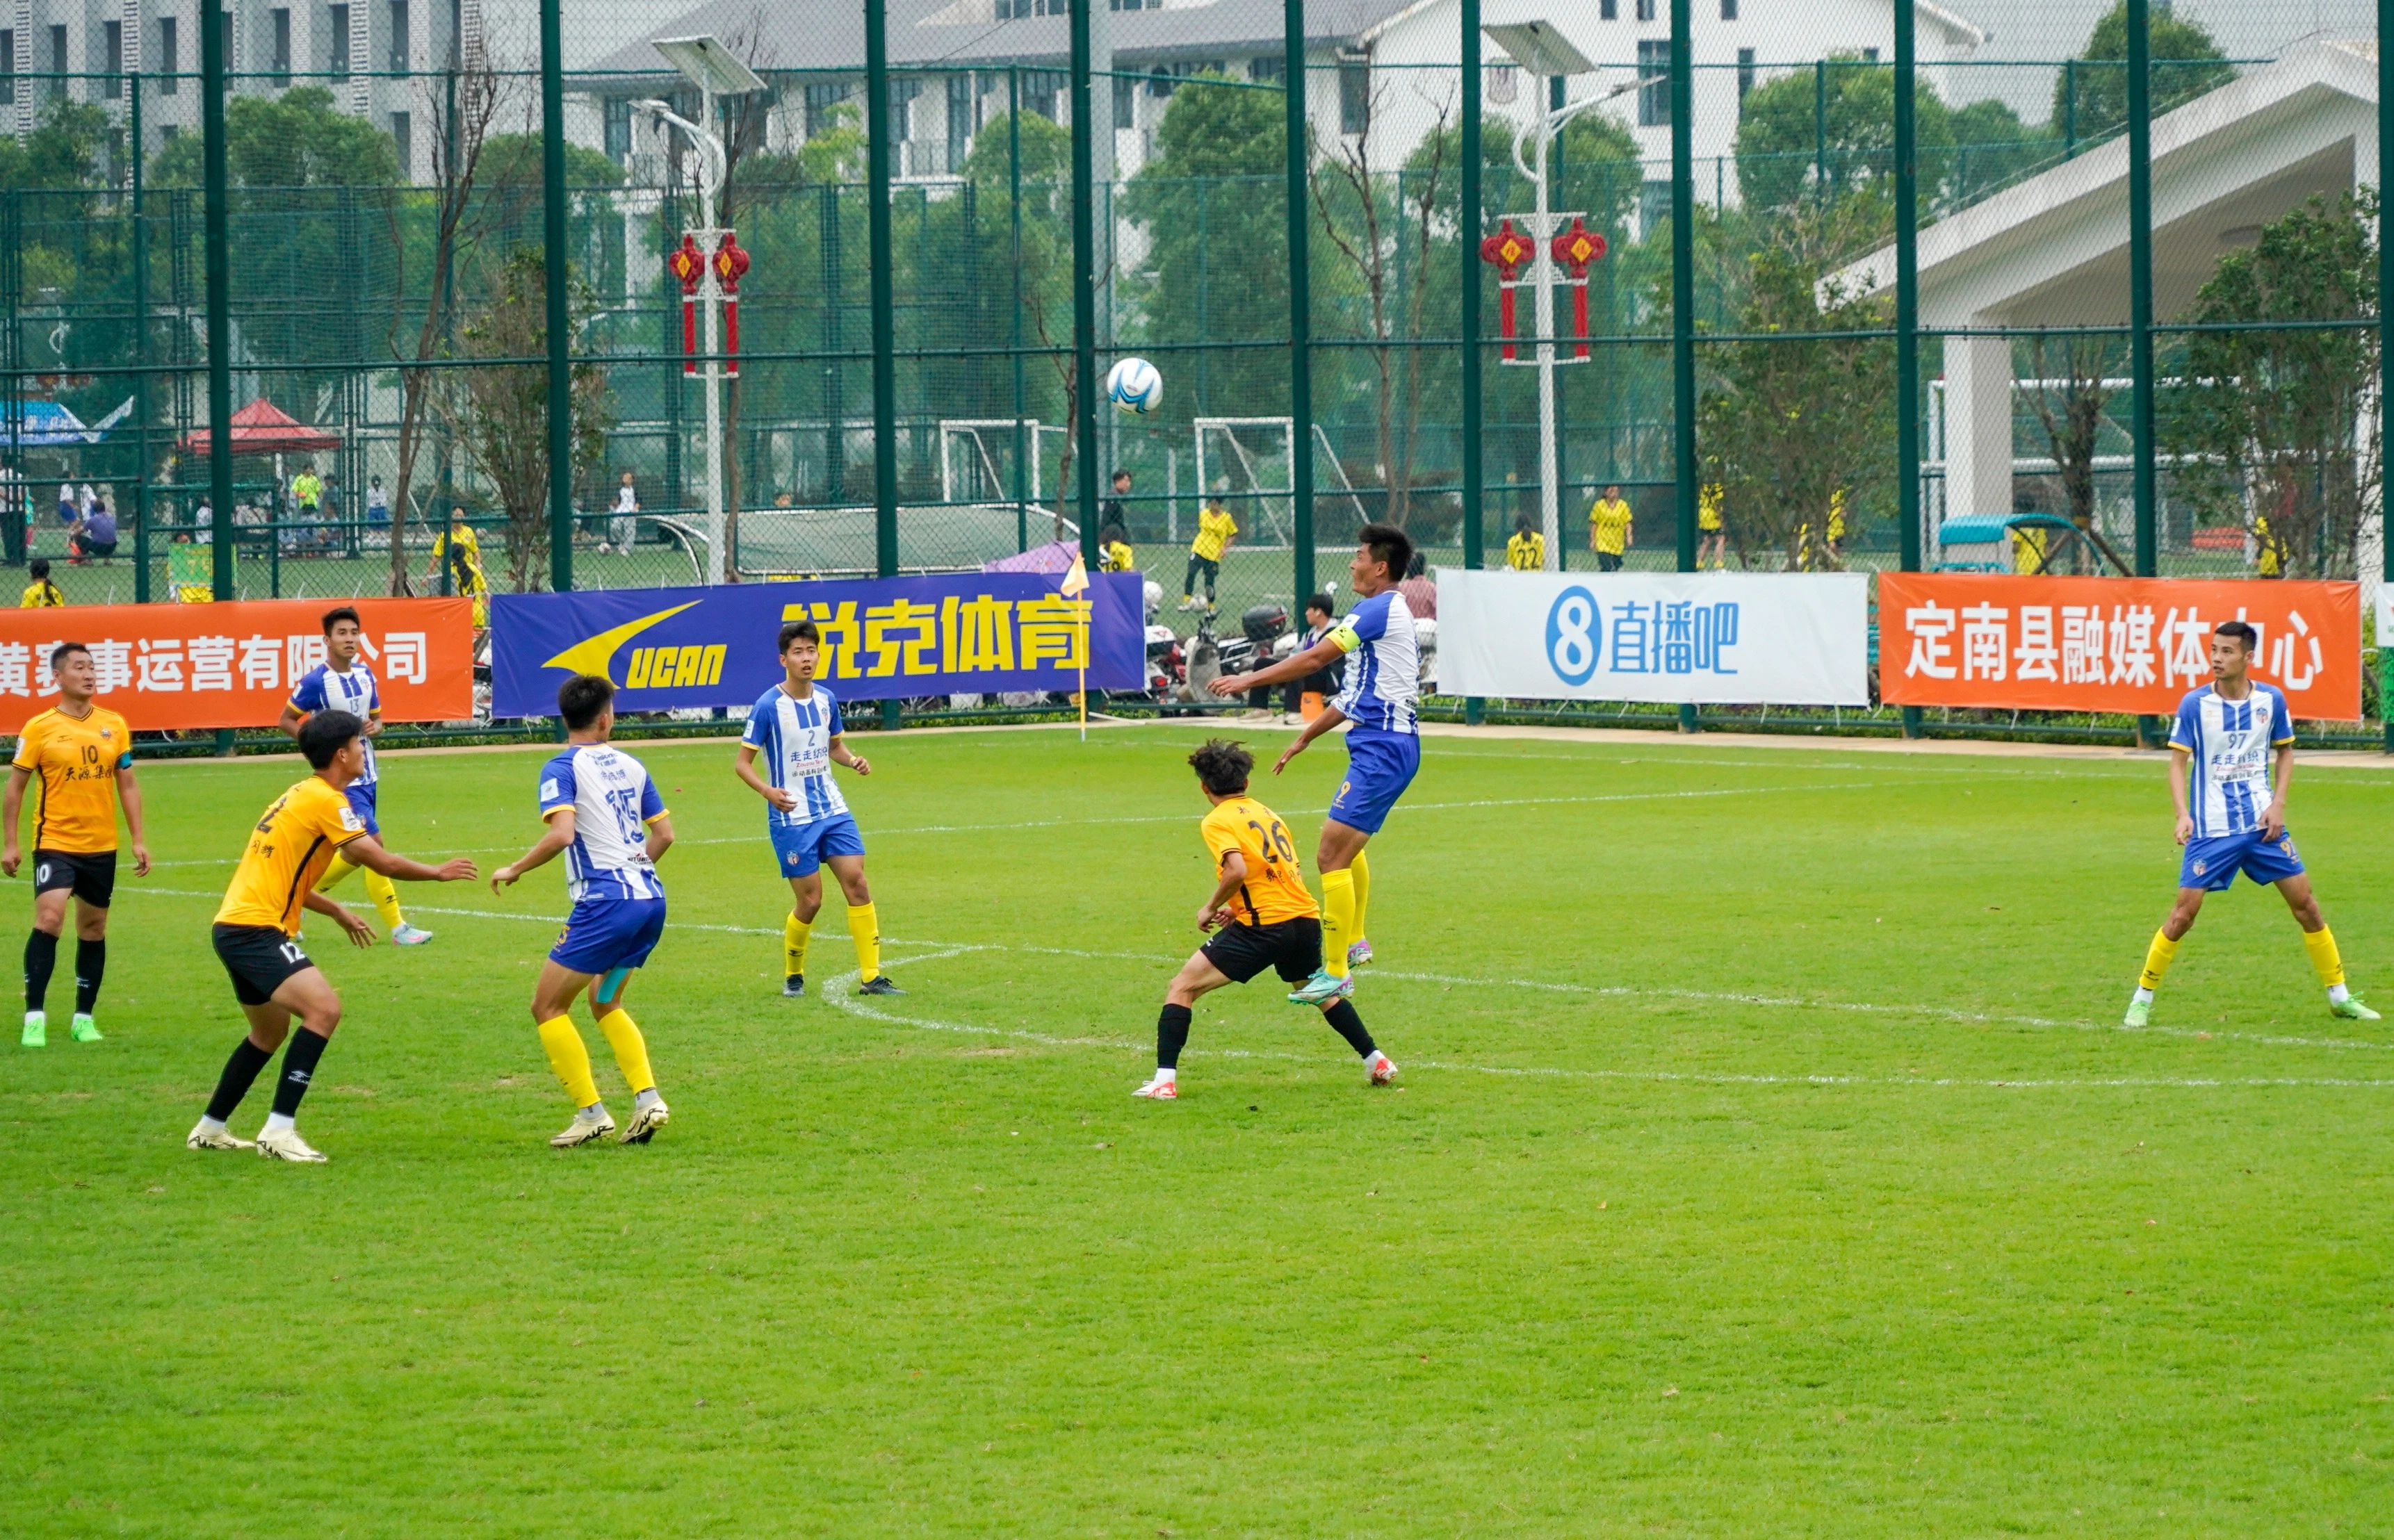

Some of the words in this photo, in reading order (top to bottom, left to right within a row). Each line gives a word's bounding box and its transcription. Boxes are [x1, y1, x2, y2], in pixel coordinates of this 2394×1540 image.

[1609, 600, 1738, 673] 直播吧
[626, 644, 727, 689] UCAN
[350, 698, 359, 713] 13
[808, 730, 815, 747] 2
[2228, 733, 2247, 749] 97
[81, 745, 99, 764] 10
[1340, 780, 1351, 798] 9
[605, 787, 644, 844] 15
[1248, 820, 1293, 863] 26
[36, 864, 51, 886] 10
[279, 942, 306, 964] 12
